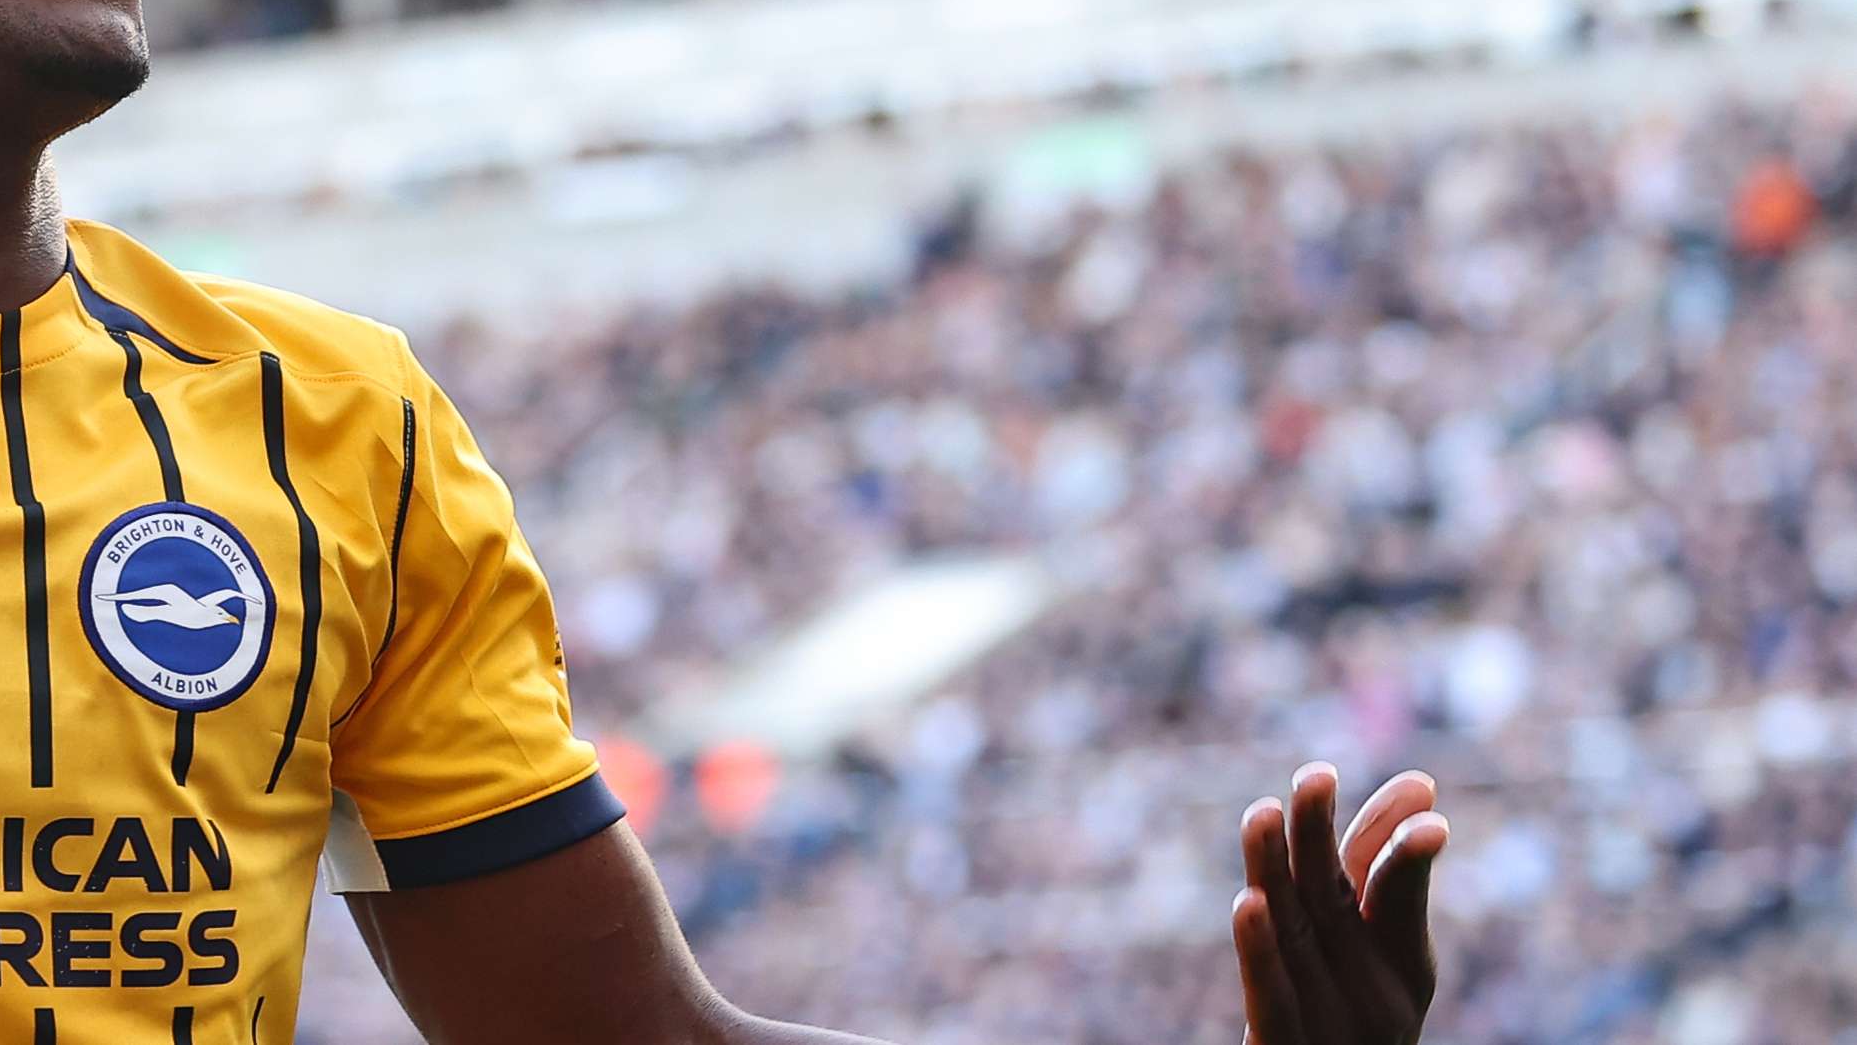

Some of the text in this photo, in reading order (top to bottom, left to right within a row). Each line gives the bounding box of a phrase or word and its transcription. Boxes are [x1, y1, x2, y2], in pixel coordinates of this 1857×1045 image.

[107, 518, 247, 575] BRIGHTON & HOVE
[151, 671, 218, 695] ALBION
